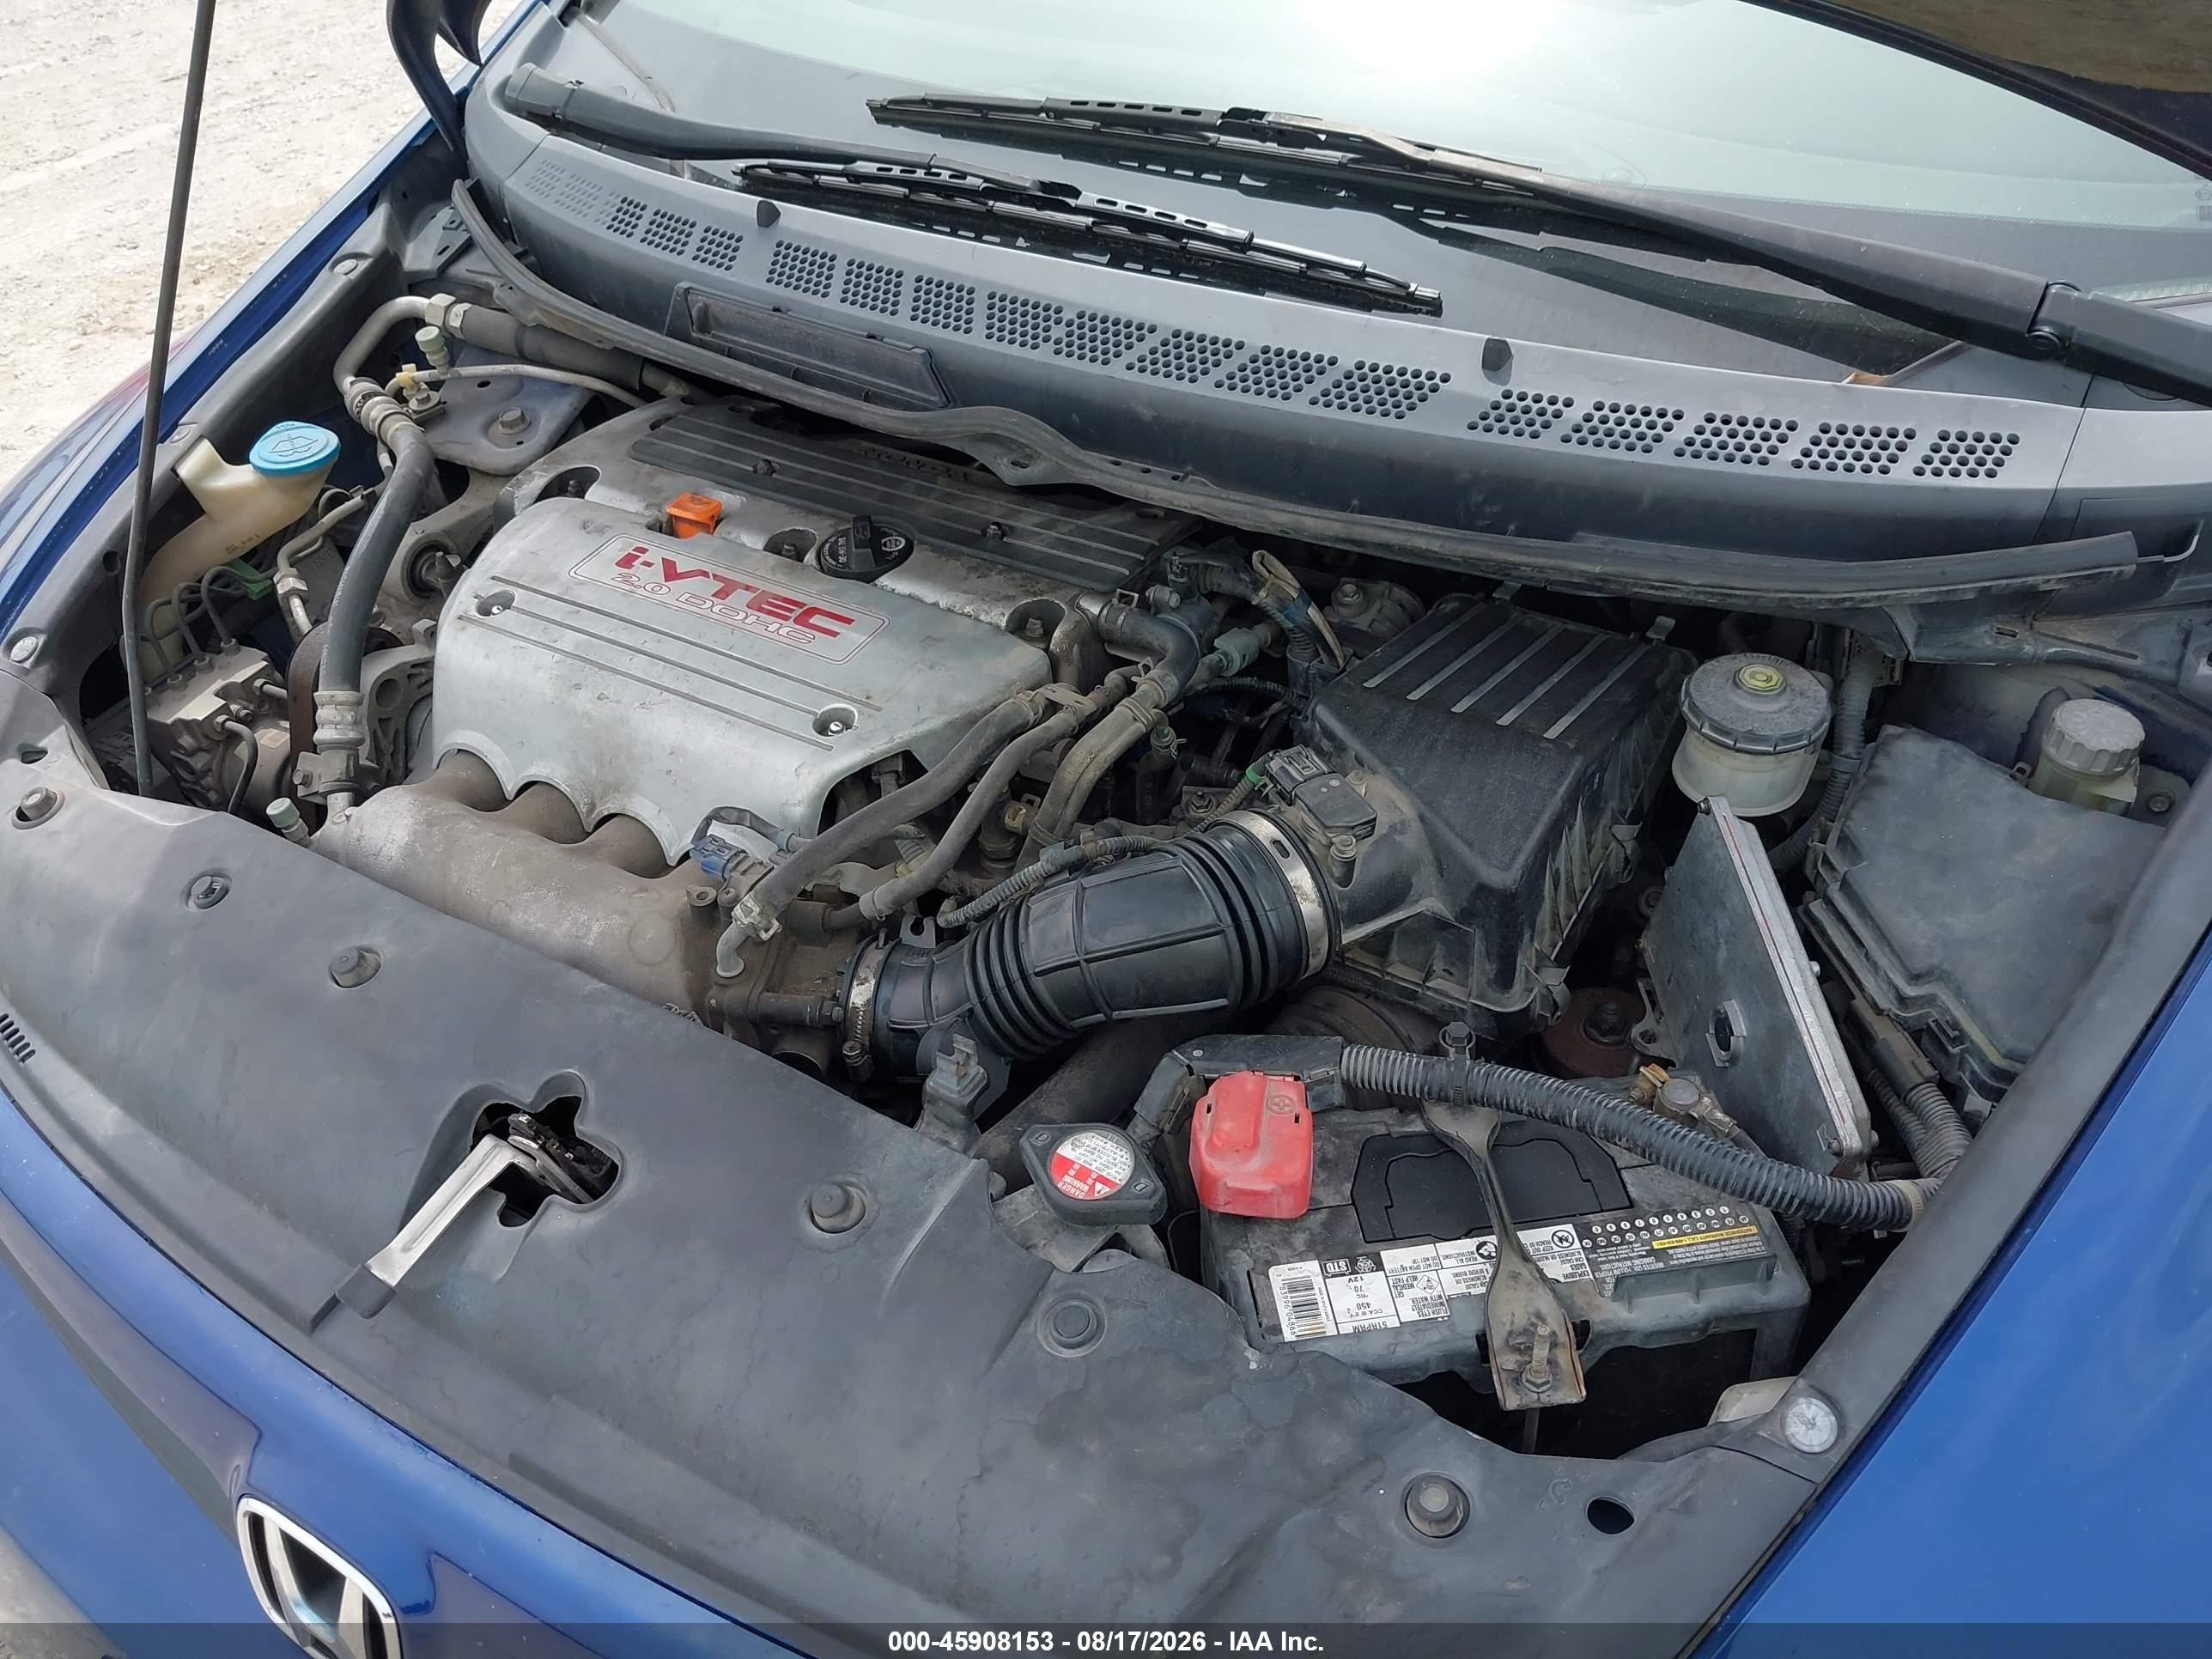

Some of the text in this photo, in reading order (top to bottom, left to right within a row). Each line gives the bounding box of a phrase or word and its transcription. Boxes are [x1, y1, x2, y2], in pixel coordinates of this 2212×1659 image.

[615, 545, 855, 638] i-VTEC
[611, 572, 816, 644] 2.0 DOHC
[1061, 1175, 1090, 1192] WARNUNG
[1057, 1181, 1086, 1198] DANGER
[1325, 1261, 1346, 1272] STD
[1570, 1262, 1586, 1271] GASES
[1561, 1269, 1589, 1279] EXPLOSIVE
[1389, 1276, 1404, 1285] FAST.
[1391, 1282, 1414, 1291] MEDICAL
[1408, 1296, 1429, 1304] WATER.
[1279, 1285, 1291, 1309] 83996
[1285, 1311, 1297, 1335] 04866
[1356, 1301, 1371, 1310] 450
[1411, 1300, 1445, 1311] IMMEDIATELY
[1431, 1307, 1447, 1316] FLUSH
